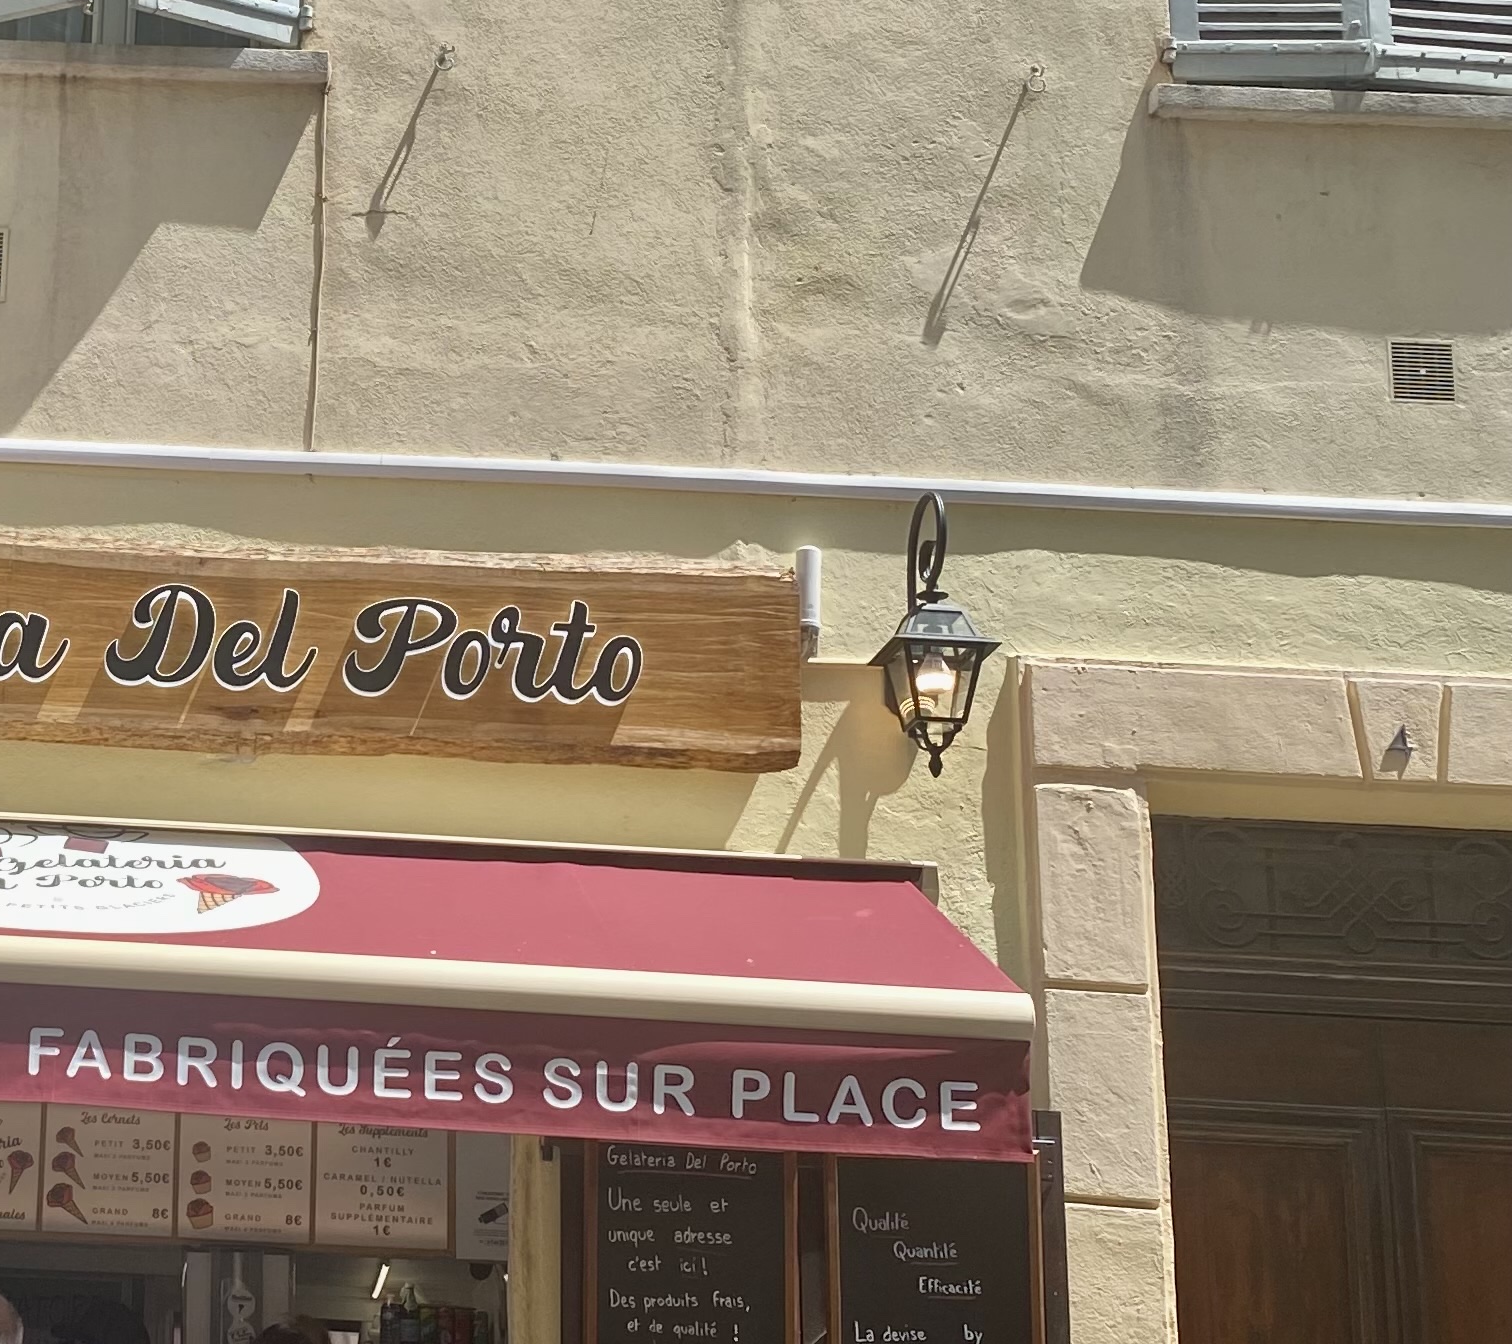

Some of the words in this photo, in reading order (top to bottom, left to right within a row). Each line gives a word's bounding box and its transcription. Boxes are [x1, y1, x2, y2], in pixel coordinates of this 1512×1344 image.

[102, 581, 317, 693] Del
[343, 596, 644, 708] Porto
[36, 874, 163, 888] Porto
[27, 1026, 511, 1105] FABRIQUÉES
[543, 1056, 694, 1117] SUR
[731, 1068, 981, 1133] PLACE
[94, 1139, 124, 1148] PETIT
[132, 1138, 171, 1151] 3,50€
[226, 1146, 256, 1154] PETIT
[265, 1145, 304, 1158] 3,50€
[352, 1145, 414, 1156] CHANTILLY
[374, 1158, 392, 1168] 1€
[607, 1145, 676, 1167] Gelateria
[685, 1151, 706, 1169] Del
[720, 1153, 757, 1175] Porto
[93, 1172, 128, 1181] MOYEN
[131, 1172, 170, 1185] 5,50€
[225, 1179, 261, 1188] MOYEN
[264, 1178, 303, 1191] 5,50€
[324, 1172, 377, 1183] CARAMEL
[390, 1176, 442, 1186] NUTELLA
[360, 1185, 405, 1198] 0,50€
[608, 1187, 643, 1212] Une
[653, 1194, 692, 1213] seule
[710, 1198, 729, 1213] et
[92, 1207, 129, 1216] GRAND
[152, 1208, 169, 1219] 8€
[359, 1203, 405, 1212] PARFUM
[225, 1213, 262, 1222] GRAND
[285, 1215, 303, 1226] 8€
[330, 1212, 433, 1225] SUPPLÉMENTAIRE
[852, 1207, 910, 1234] Qualité
[373, 1226, 391, 1236] 1€
[608, 1229, 656, 1248] unique
[674, 1226, 732, 1245] adresse
[893, 1240, 958, 1261] Quantité
[628, 1255, 661, 1272] c'est
[918, 1276, 982, 1295] Efficacité
[610, 1288, 636, 1309] Des
[644, 1292, 699, 1313] produits
[627, 1318, 640, 1332] et
[649, 1319, 663, 1333] de
[673, 1321, 717, 1339] qualité
[854, 1320, 875, 1343] La
[882, 1323, 927, 1342] devise
